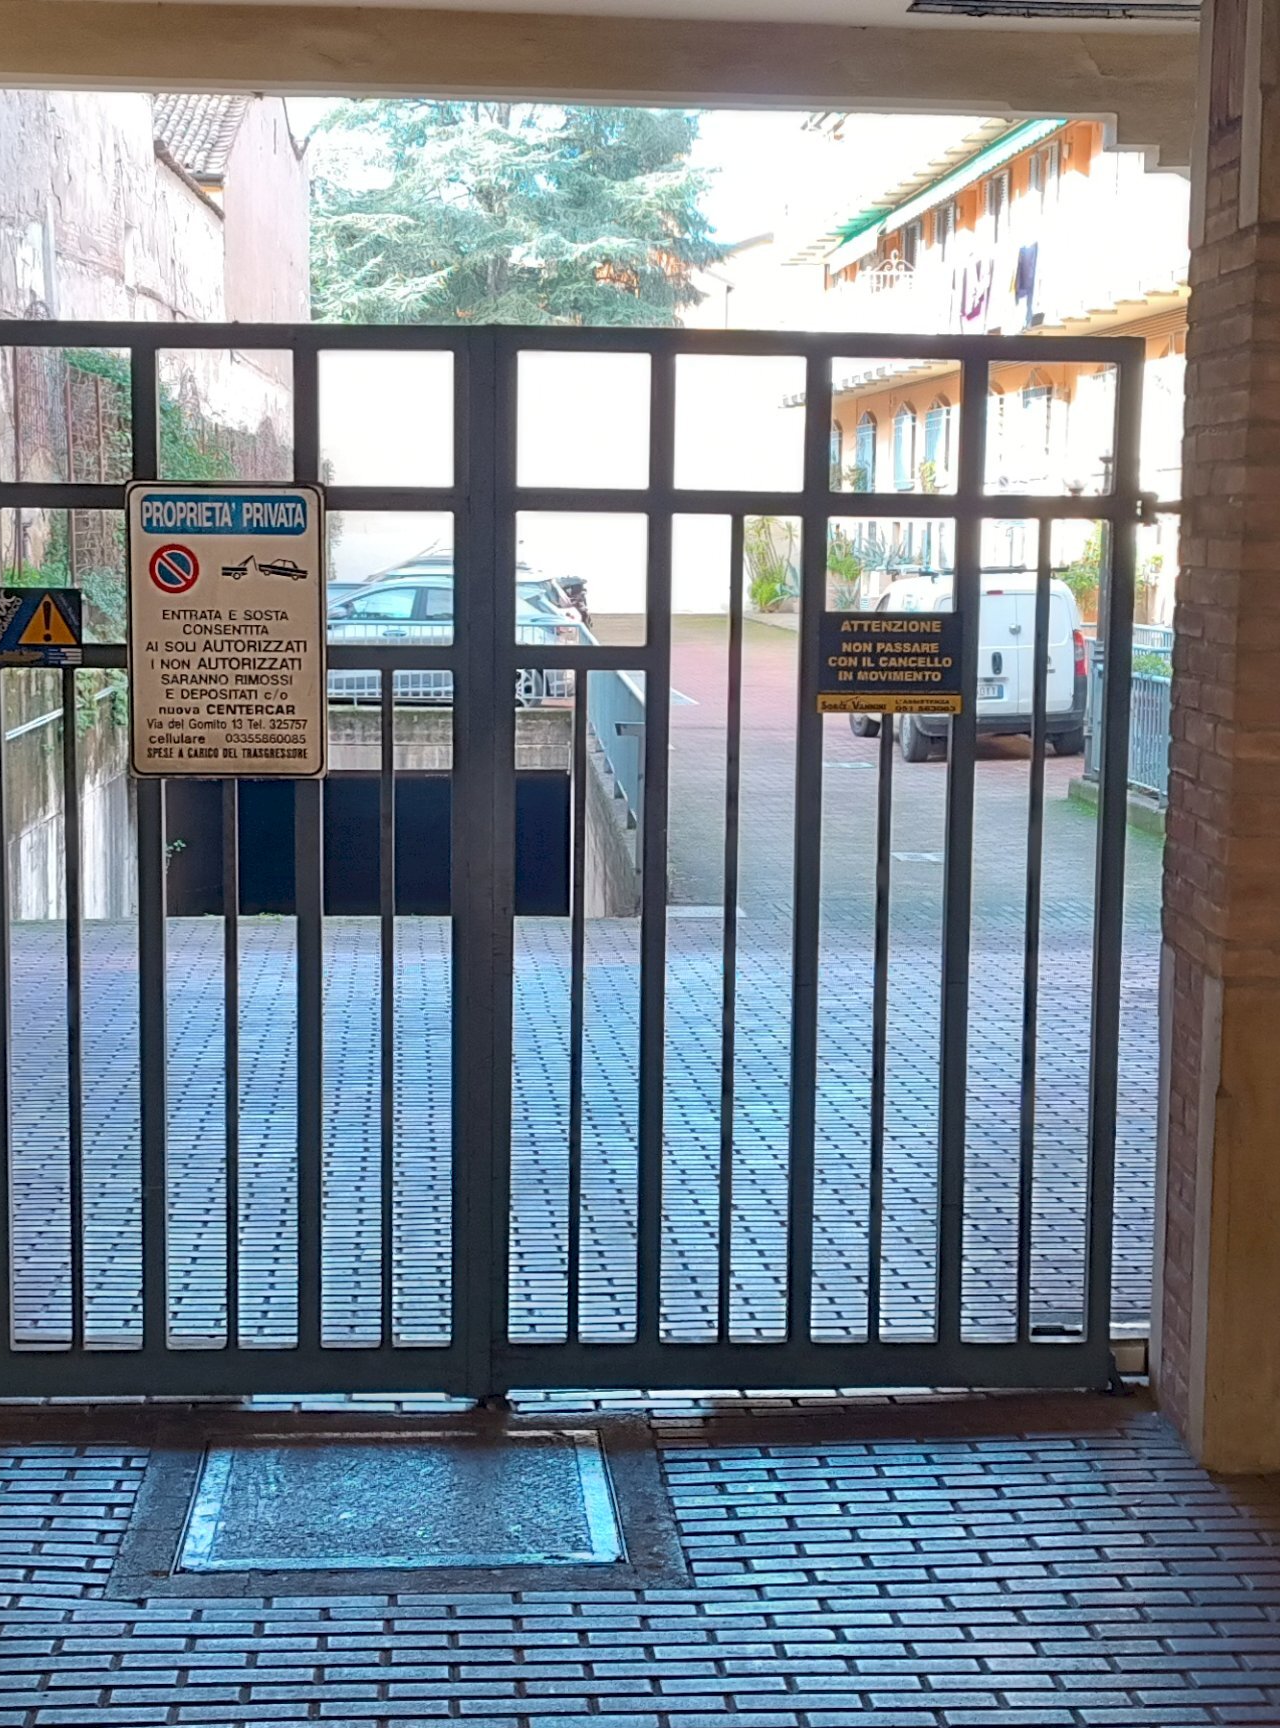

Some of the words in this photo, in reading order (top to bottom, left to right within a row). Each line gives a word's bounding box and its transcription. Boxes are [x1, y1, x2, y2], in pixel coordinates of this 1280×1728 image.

[141, 500, 236, 528] PROPRIETA'
[242, 502, 305, 528] PRIVATA
[162, 610, 221, 621] ENTRATA
[229, 610, 237, 621] E
[244, 610, 289, 621] SOSTA
[182, 624, 269, 635] CONSENTITA
[841, 620, 942, 632] ATTENZIONE
[146, 641, 158, 652] AI
[165, 641, 196, 652] SOLI
[203, 640, 307, 653] AUTORIZZATI
[842, 642, 872, 653] NON
[876, 643, 940, 653] PASSARE
[160, 659, 190, 670] NON
[197, 658, 302, 671] AUTORIZZATI
[828, 657, 858, 667] CON
[862, 657, 876, 667] IL
[879, 657, 953, 667] CANCELLO
[161, 674, 228, 686] SARANNO
[235, 674, 293, 686] RIMOSSI
[838, 671, 853, 681] IN
[857, 671, 942, 681] MOVIMENTO
[166, 689, 174, 700] E
[181, 689, 258, 700] DEPOSITATI
[264, 689, 288, 700] c/o
[158, 706, 200, 715] nuova
[206, 704, 295, 715] CENTERCAR
[147, 719, 164, 729] Via
[168, 719, 184, 729] del
[188, 719, 227, 729] Gomito
[232, 719, 243, 729] 13
[248, 719, 266, 729] Tel.
[269, 719, 308, 730] 325757
[149, 734, 206, 744] cellulare
[225, 734, 306, 744] 03355860085
[147, 748, 174, 759] SPESE
[178, 748, 184, 759] A
[188, 748, 219, 759] CARICO
[223, 748, 238, 759] DEL
[242, 748, 308, 759] TRASGRESSORE
